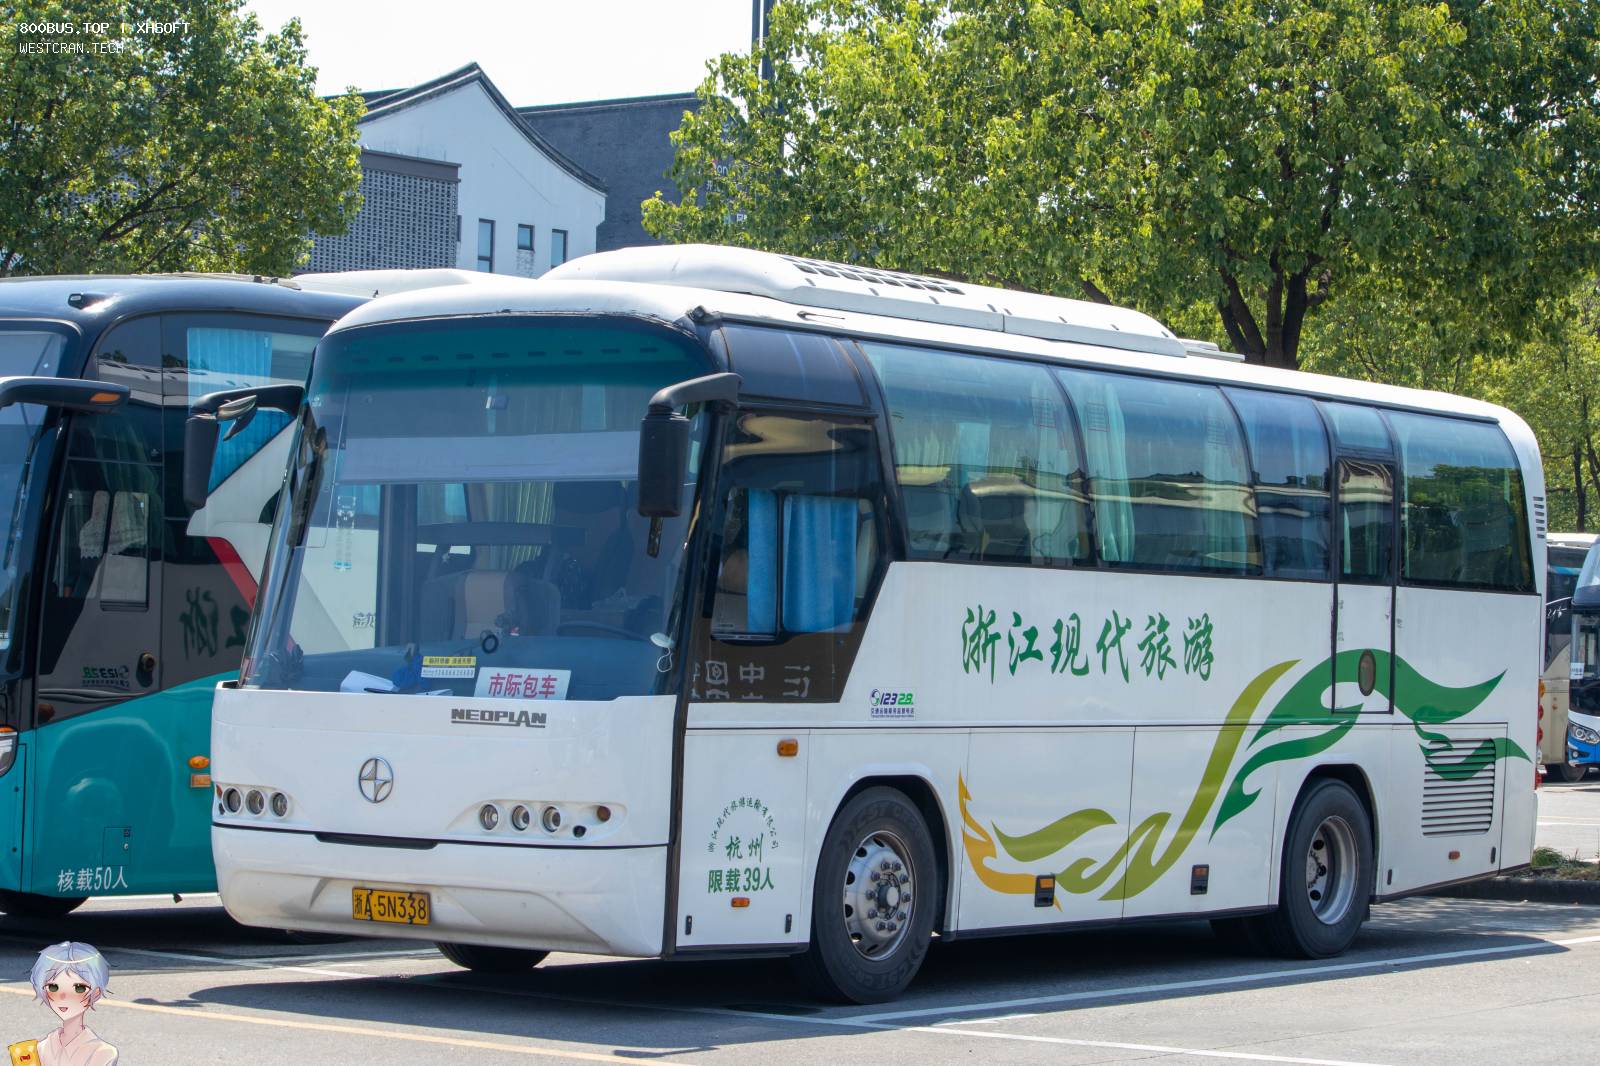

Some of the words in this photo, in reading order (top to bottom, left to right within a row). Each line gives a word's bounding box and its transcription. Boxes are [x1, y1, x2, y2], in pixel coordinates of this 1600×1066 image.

[961, 603, 1214, 685] 浙江现代旅游
[487, 673, 558, 699] 市际包车
[880, 692, 914, 706] 12328
[450, 708, 547, 727] NEOPLAN
[725, 832, 764, 863] 杭州
[57, 865, 129, 892] 核载50人
[707, 867, 775, 894] 限载39人
